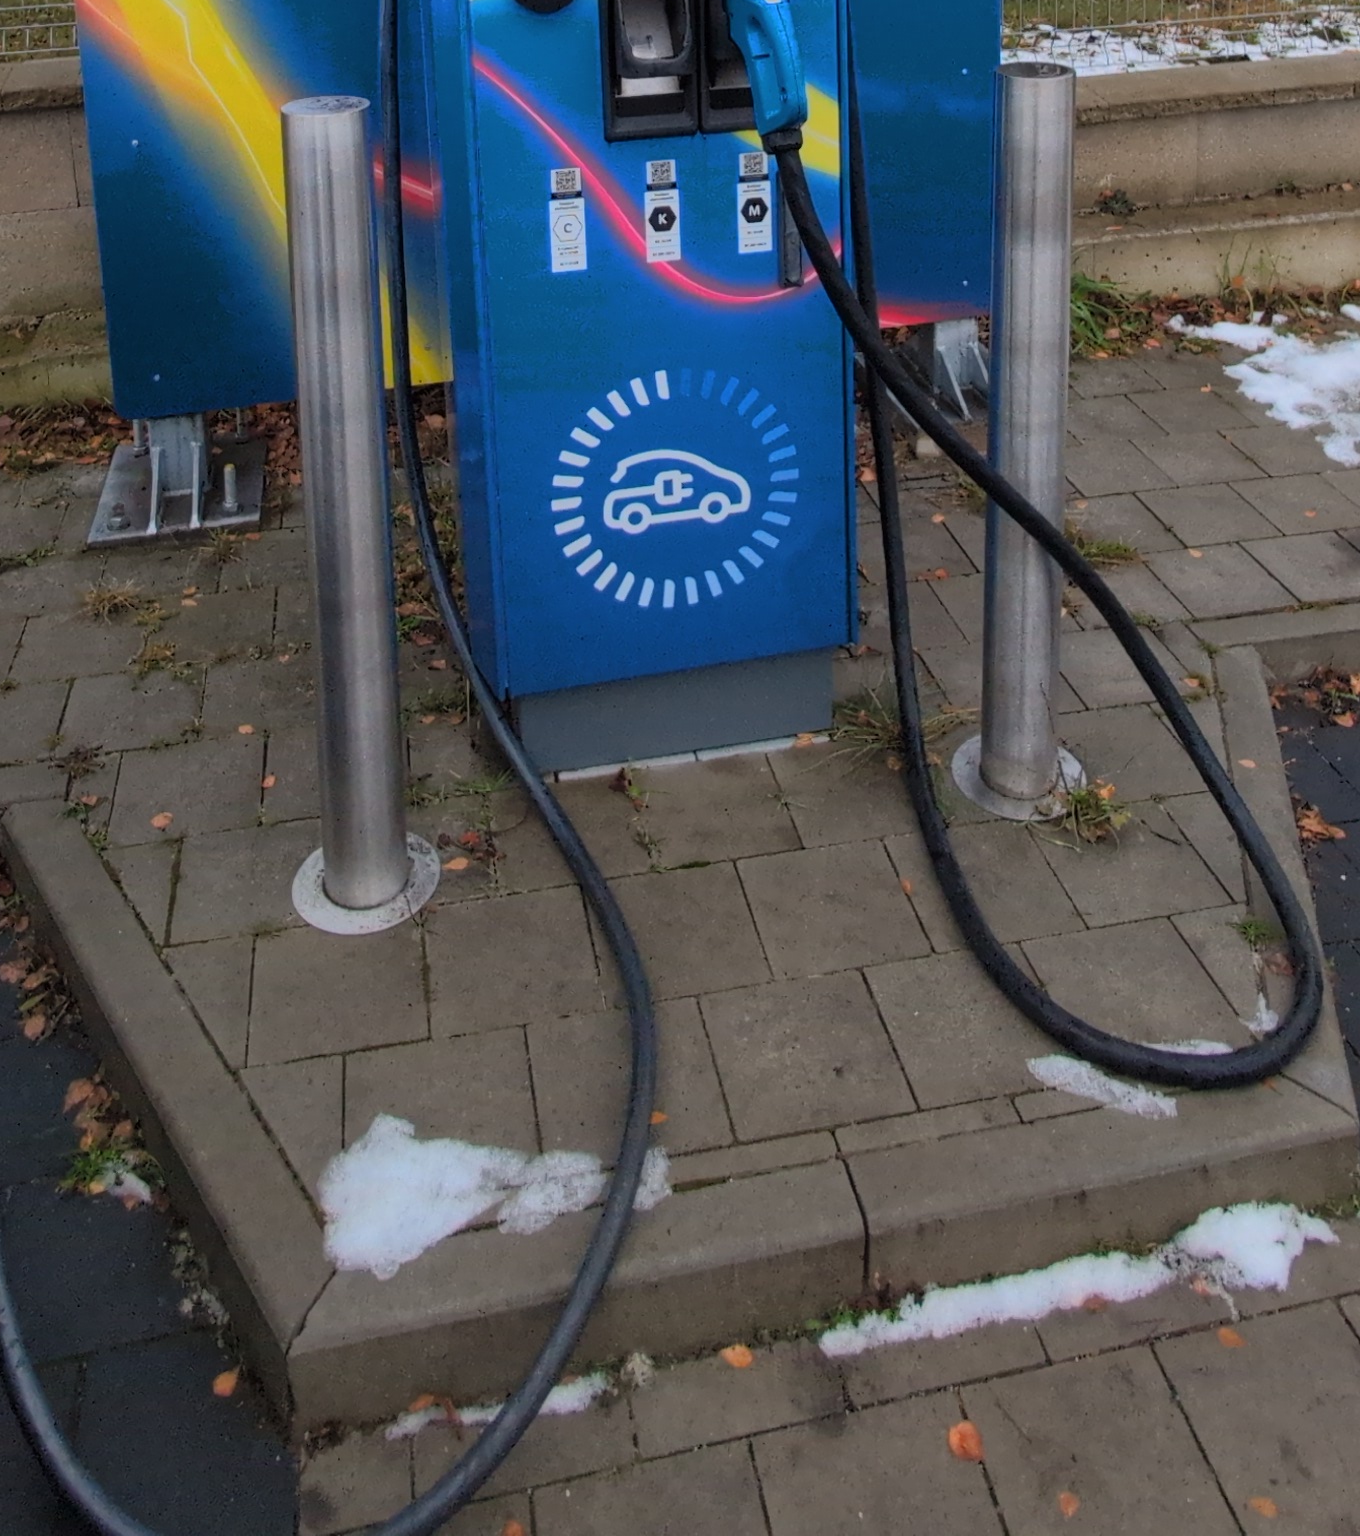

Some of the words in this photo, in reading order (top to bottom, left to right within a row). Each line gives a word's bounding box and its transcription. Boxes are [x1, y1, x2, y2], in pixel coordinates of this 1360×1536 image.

[749, 204, 760, 217] M
[658, 213, 668, 225] K
[563, 222, 573, 234] C
